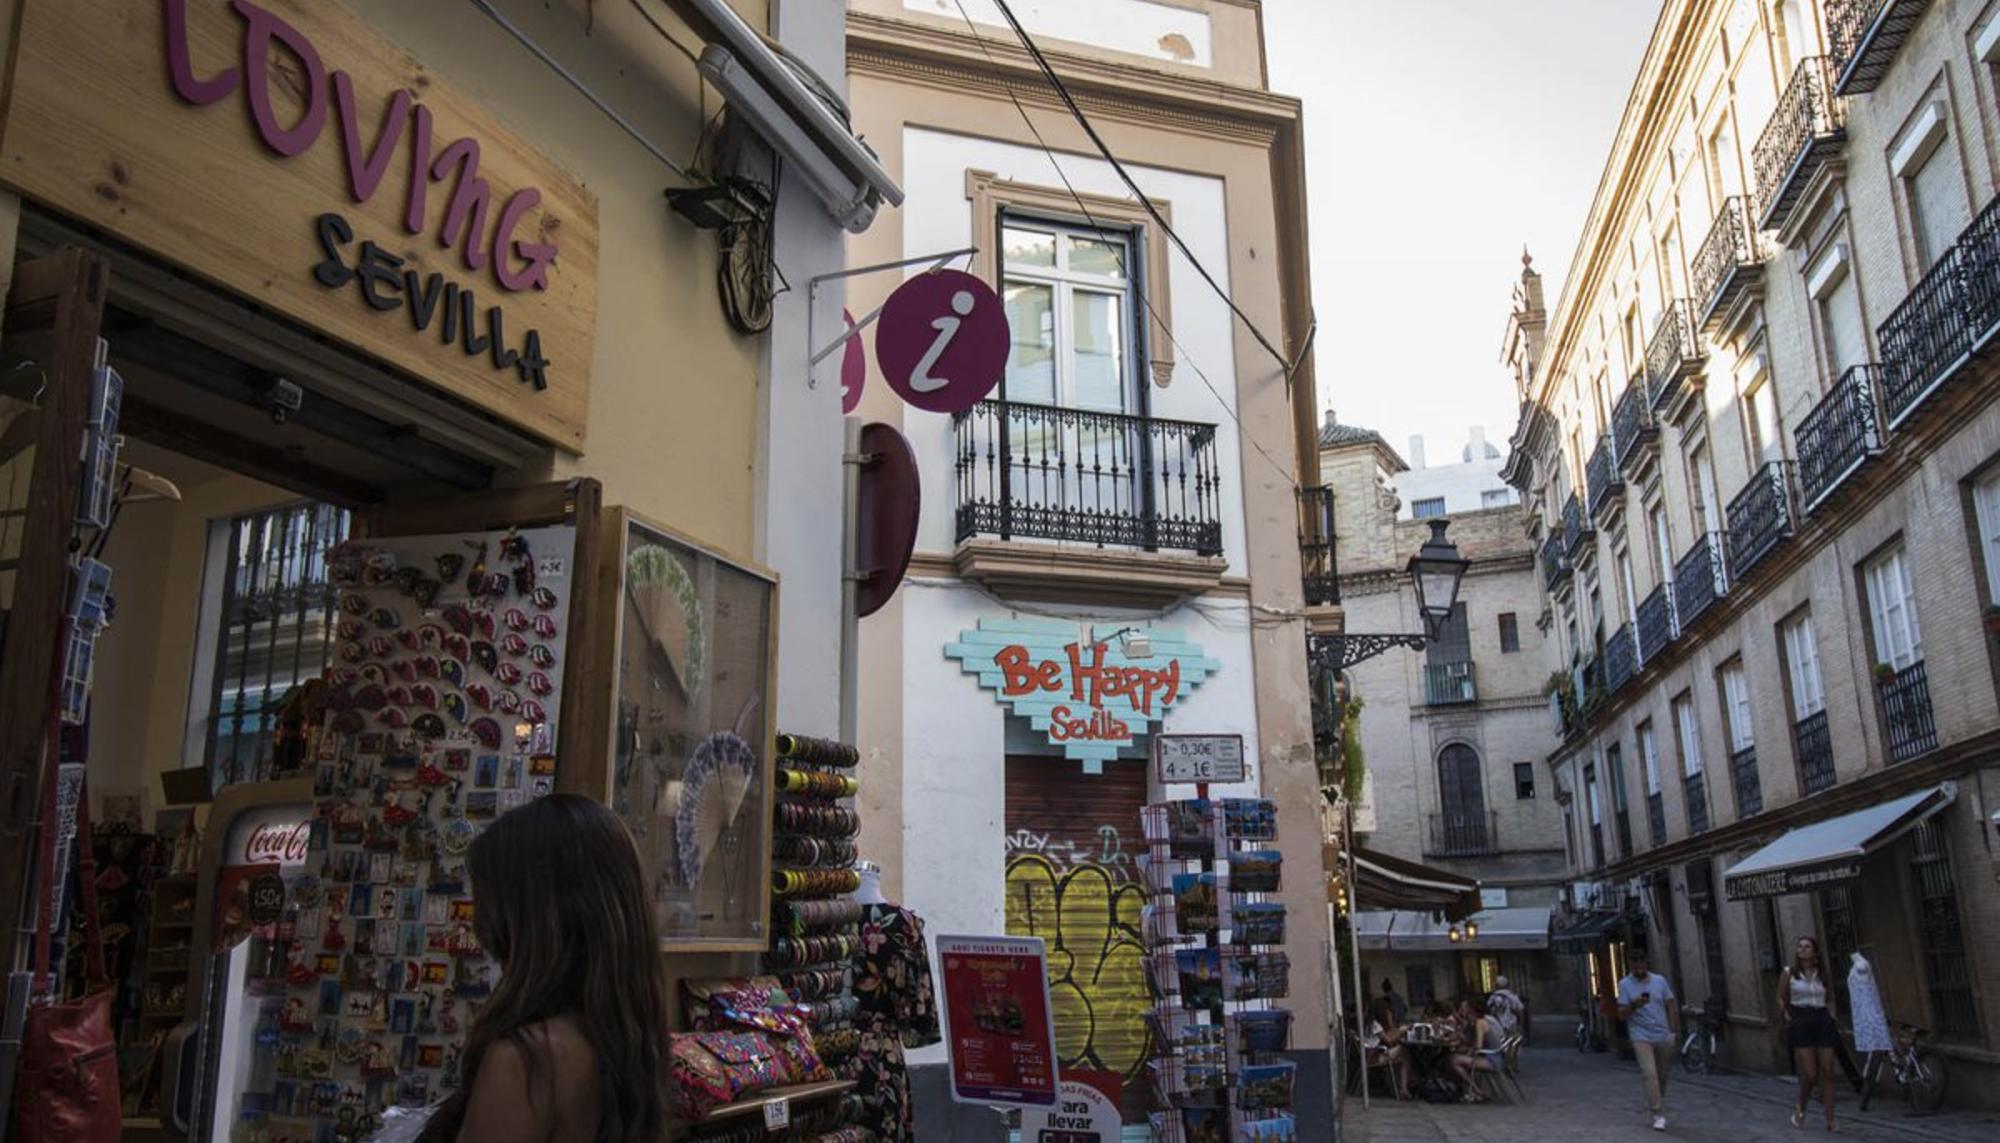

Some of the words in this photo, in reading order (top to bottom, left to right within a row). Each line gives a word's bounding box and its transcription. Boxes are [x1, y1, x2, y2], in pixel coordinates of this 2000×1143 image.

[312, 212, 550, 390] SEVILLA
[993, 643, 1062, 697] Be
[1063, 641, 1181, 717] Happy
[1049, 704, 1132, 742] Sevilla
[1180, 742, 1213, 758] 0,30€
[1166, 761, 1176, 778] 4
[1193, 760, 1211, 778] 1€
[246, 820, 312, 863] Coca-Co
[1048, 1112, 1094, 1129] llevar
[1064, 1101, 1089, 1114] ara
